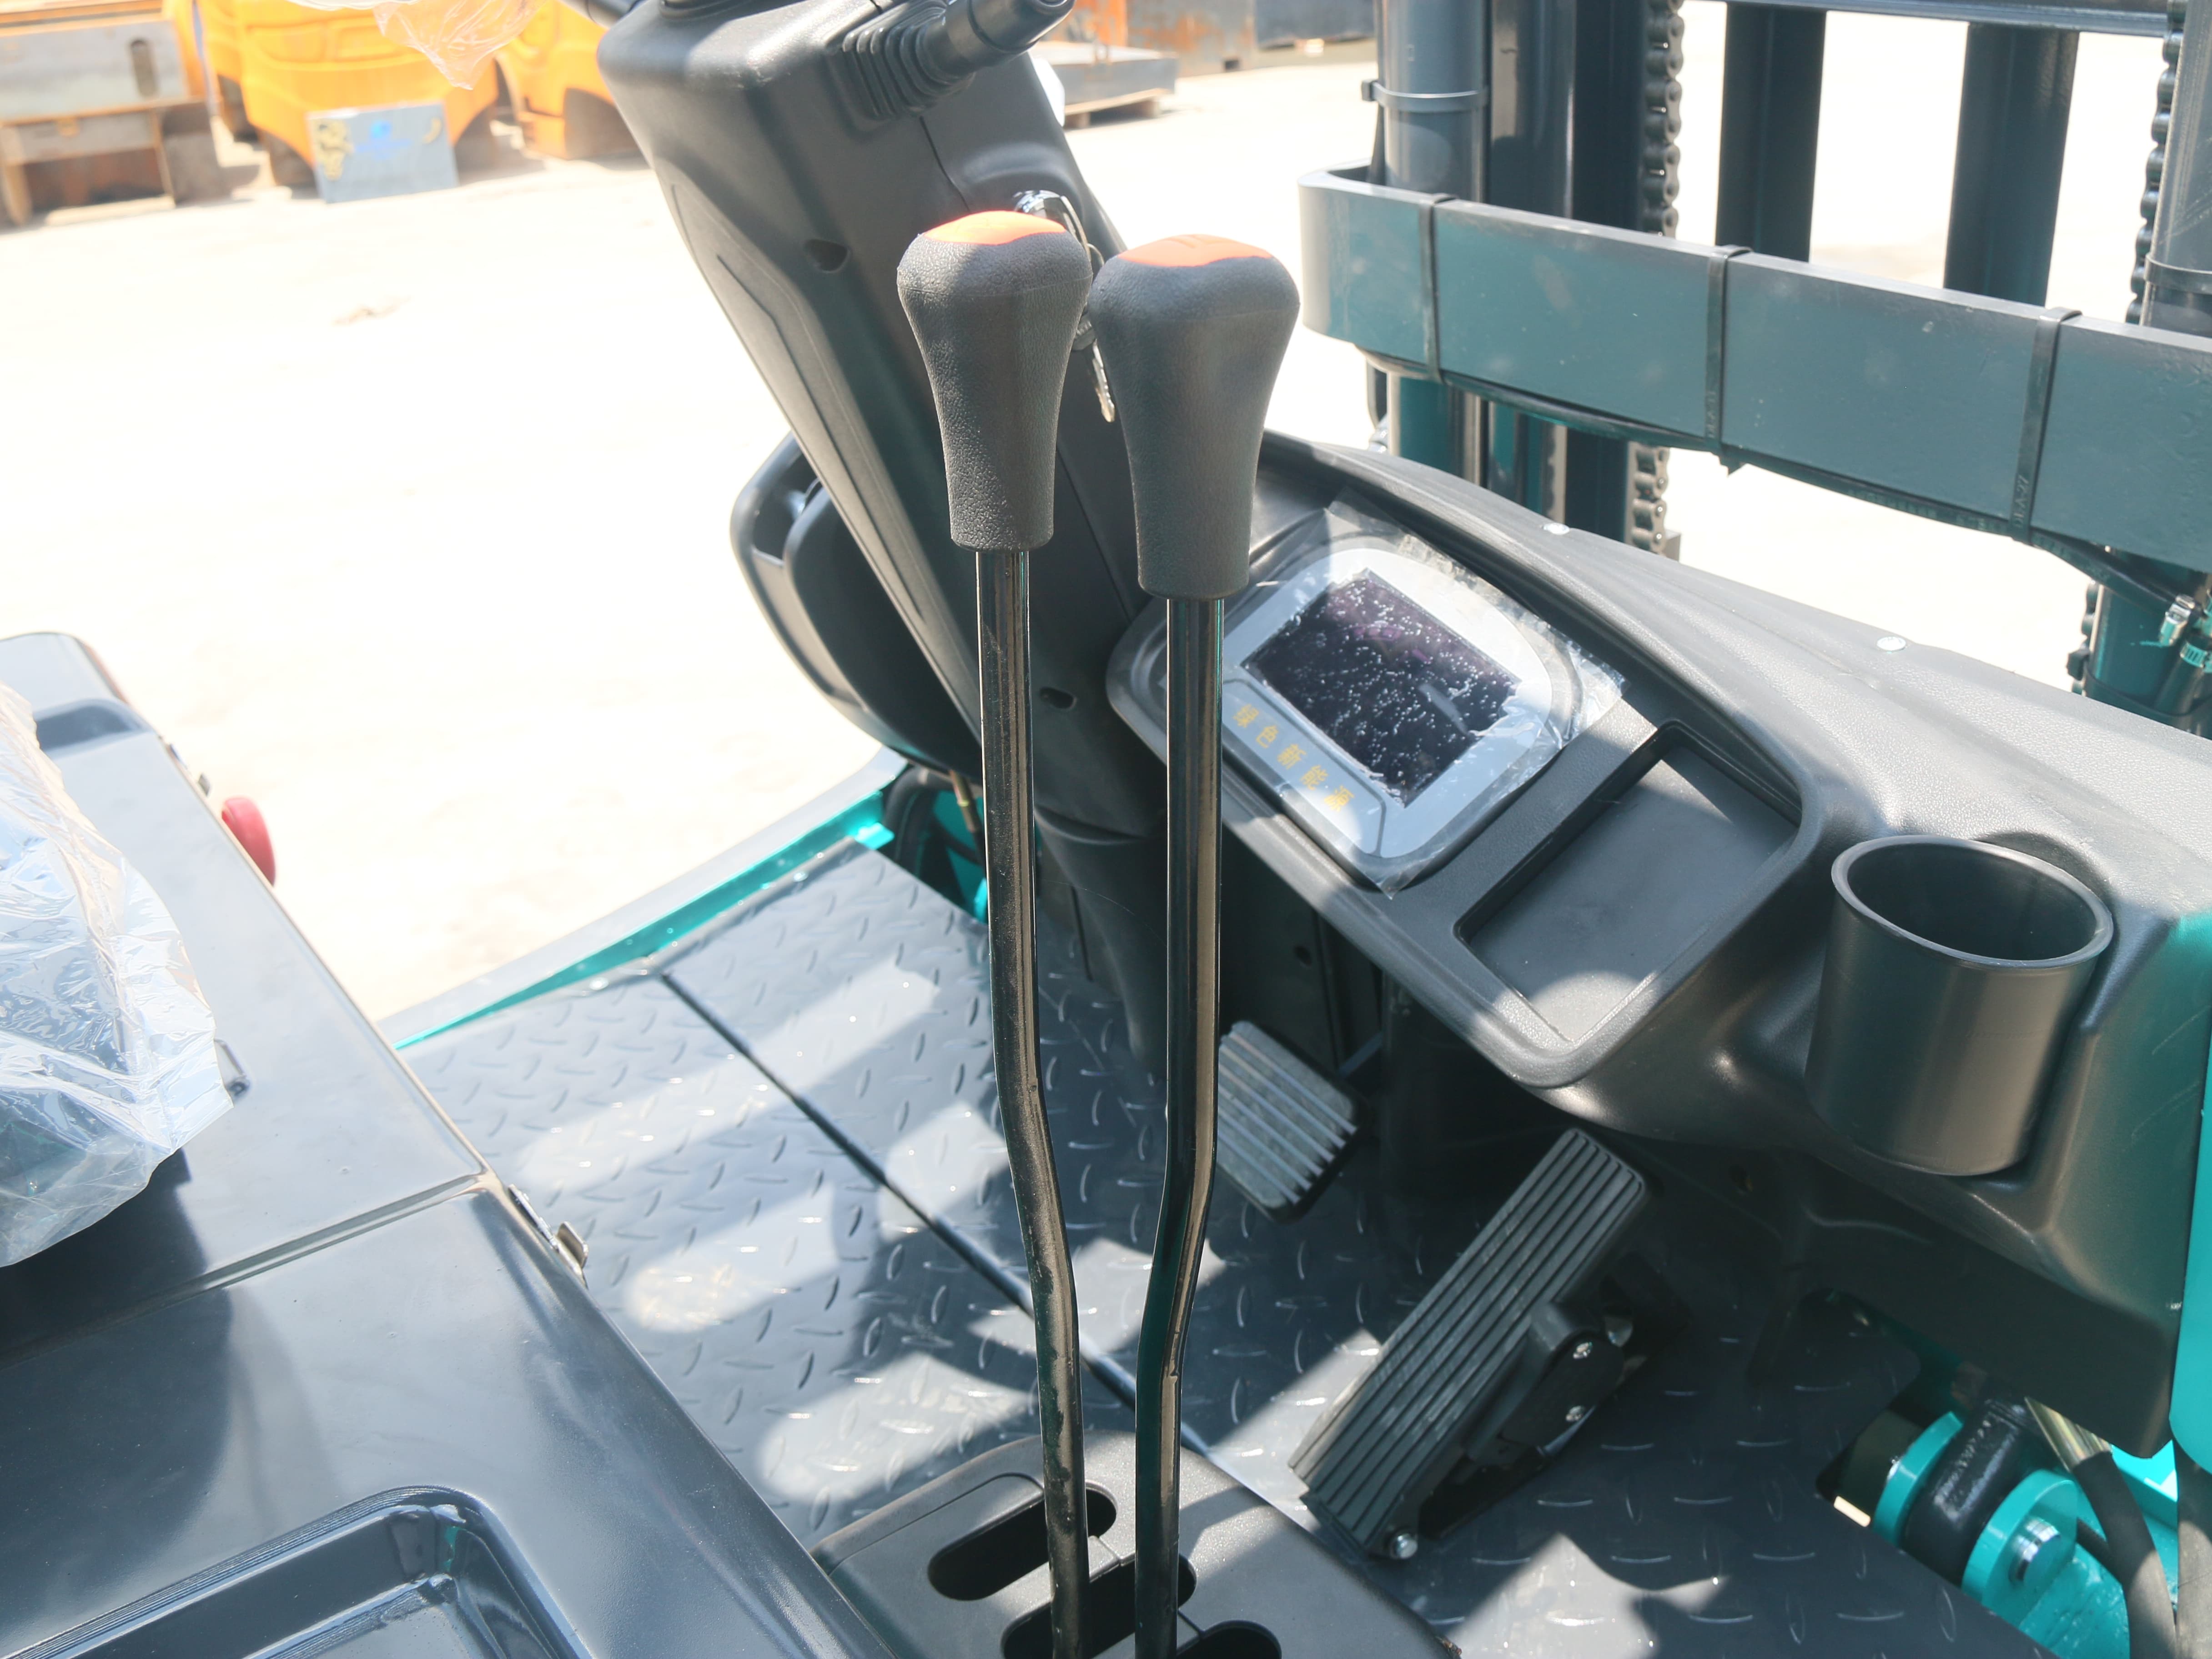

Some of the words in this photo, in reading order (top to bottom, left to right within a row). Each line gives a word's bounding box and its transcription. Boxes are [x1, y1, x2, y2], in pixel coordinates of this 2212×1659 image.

[1233, 704, 1354, 812] 绿色新能源
